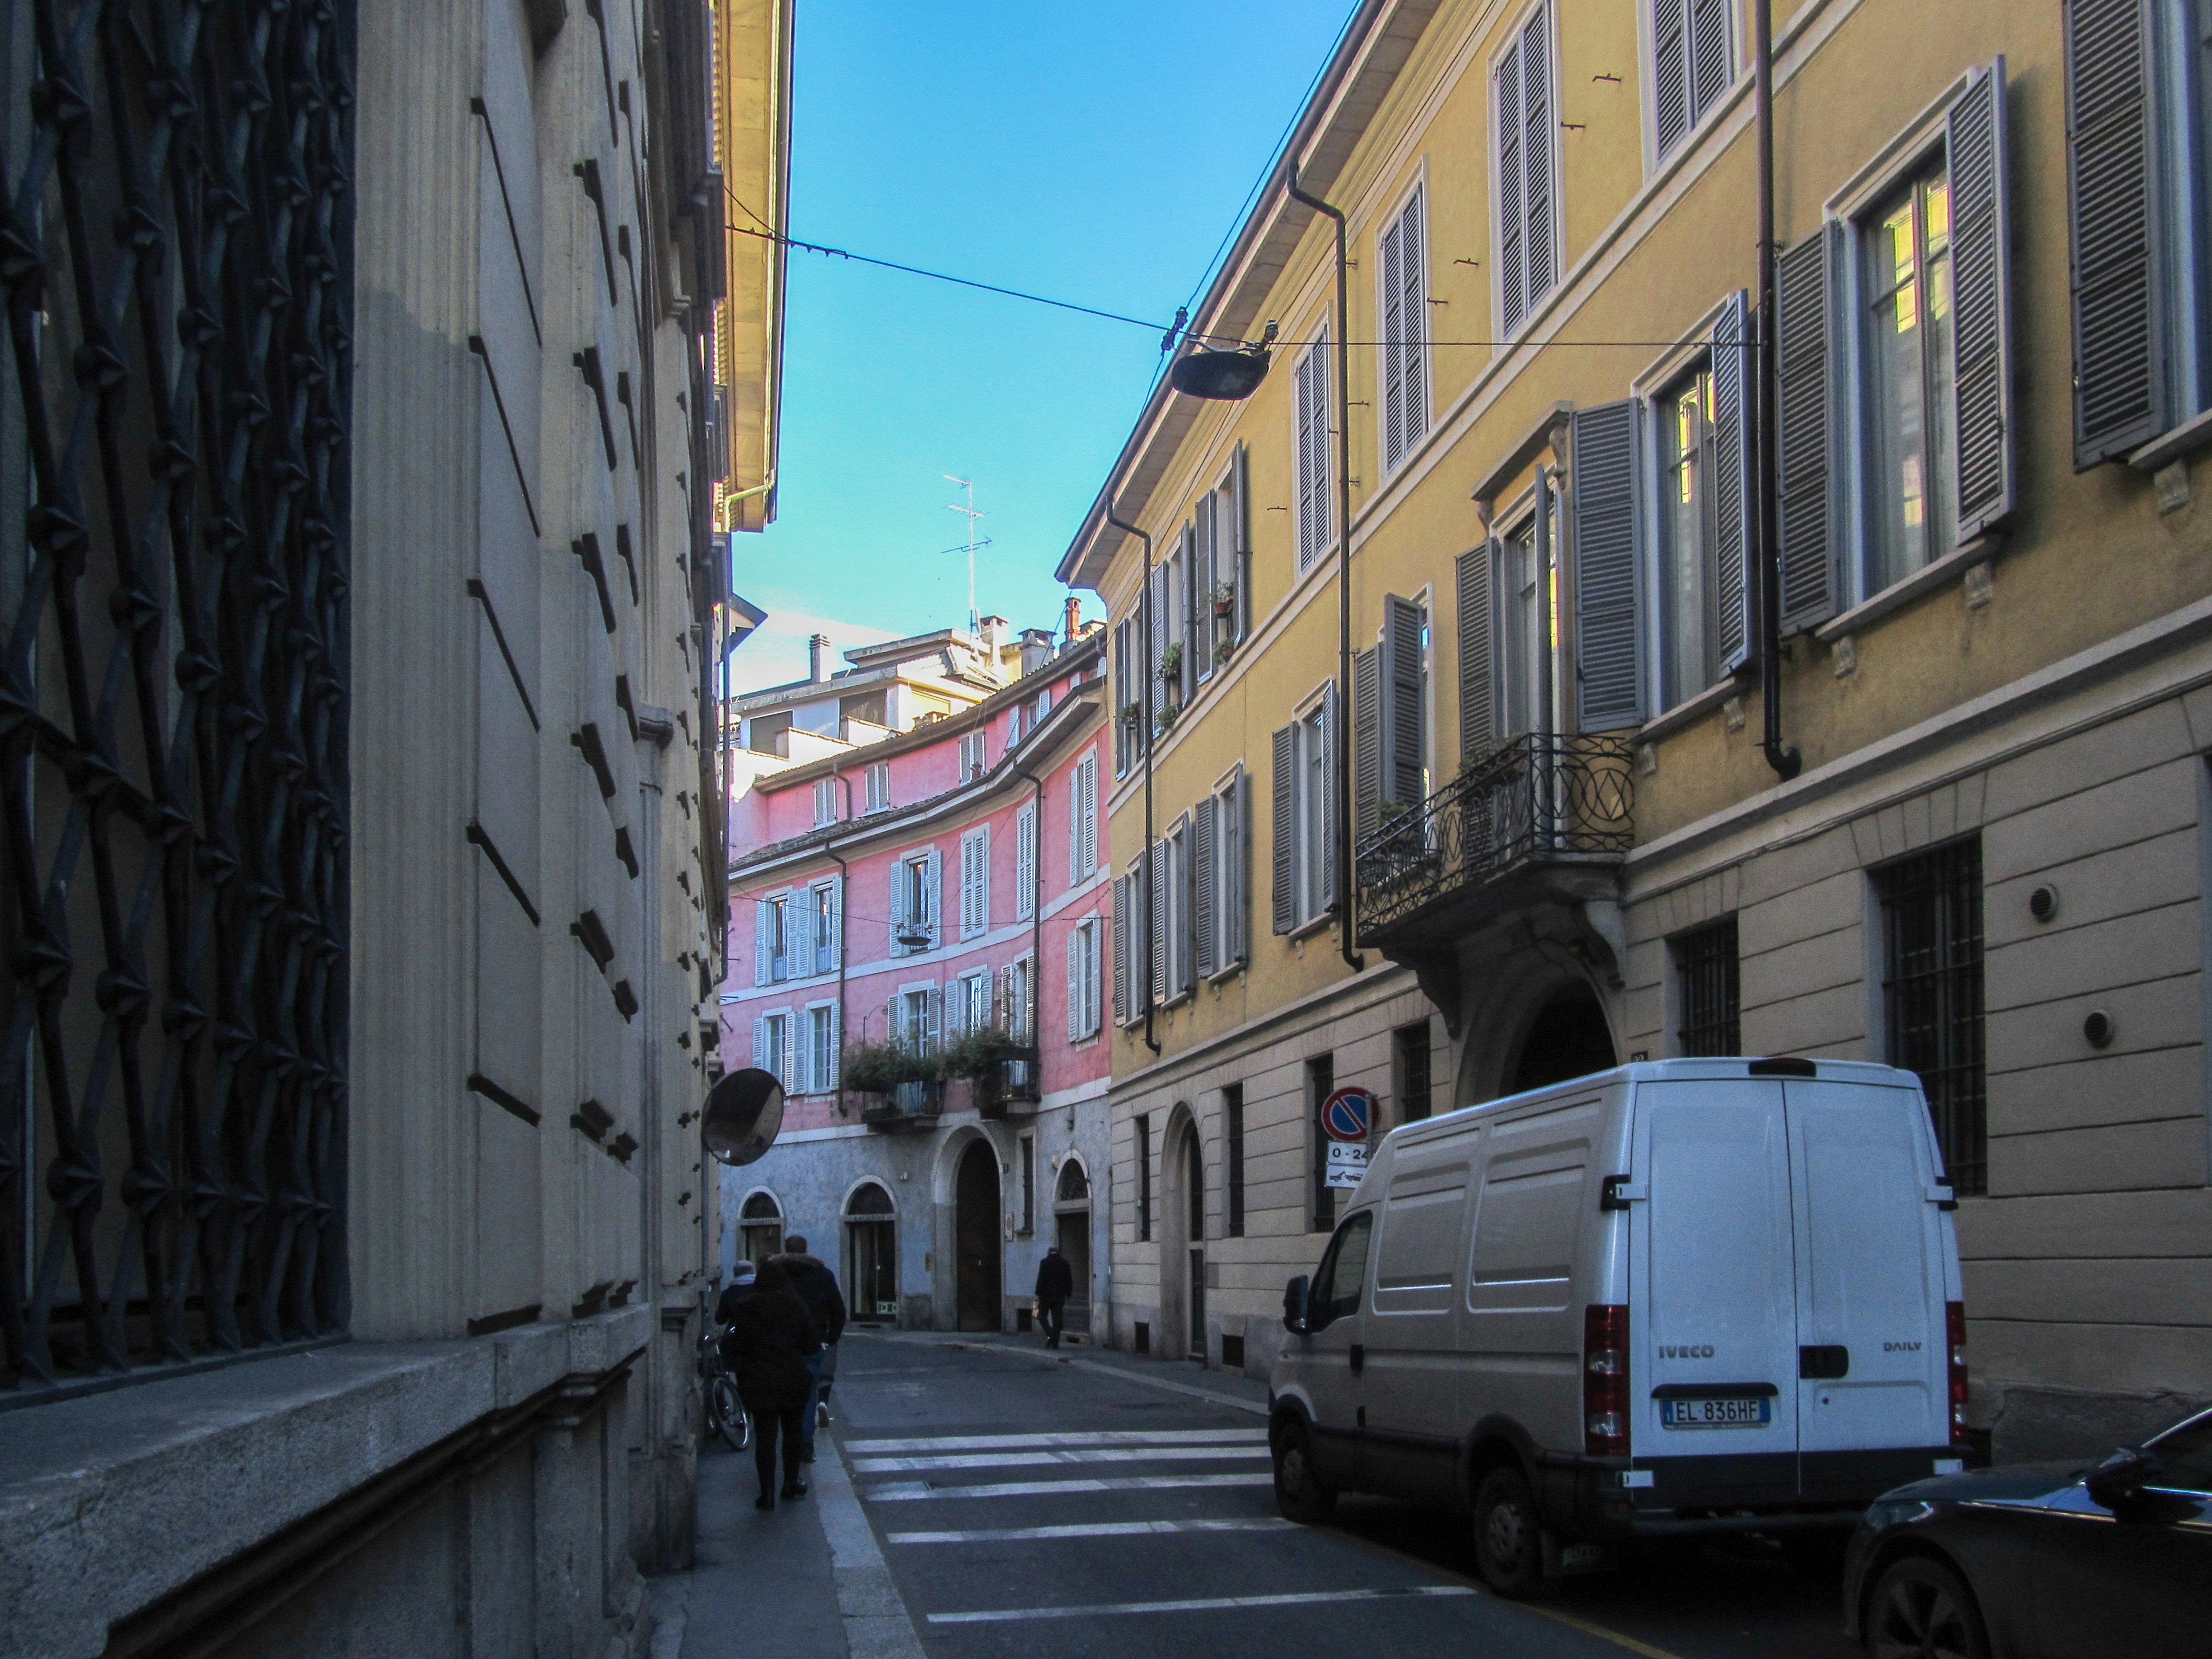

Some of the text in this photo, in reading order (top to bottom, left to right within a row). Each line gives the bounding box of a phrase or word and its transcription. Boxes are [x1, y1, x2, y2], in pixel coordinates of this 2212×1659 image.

[1332, 1148, 1341, 1158] 0
[1659, 1345, 1715, 1358] IVECO
[1883, 1342, 1922, 1352] DAILY
[1676, 1401, 1757, 1421] EL 836HF
